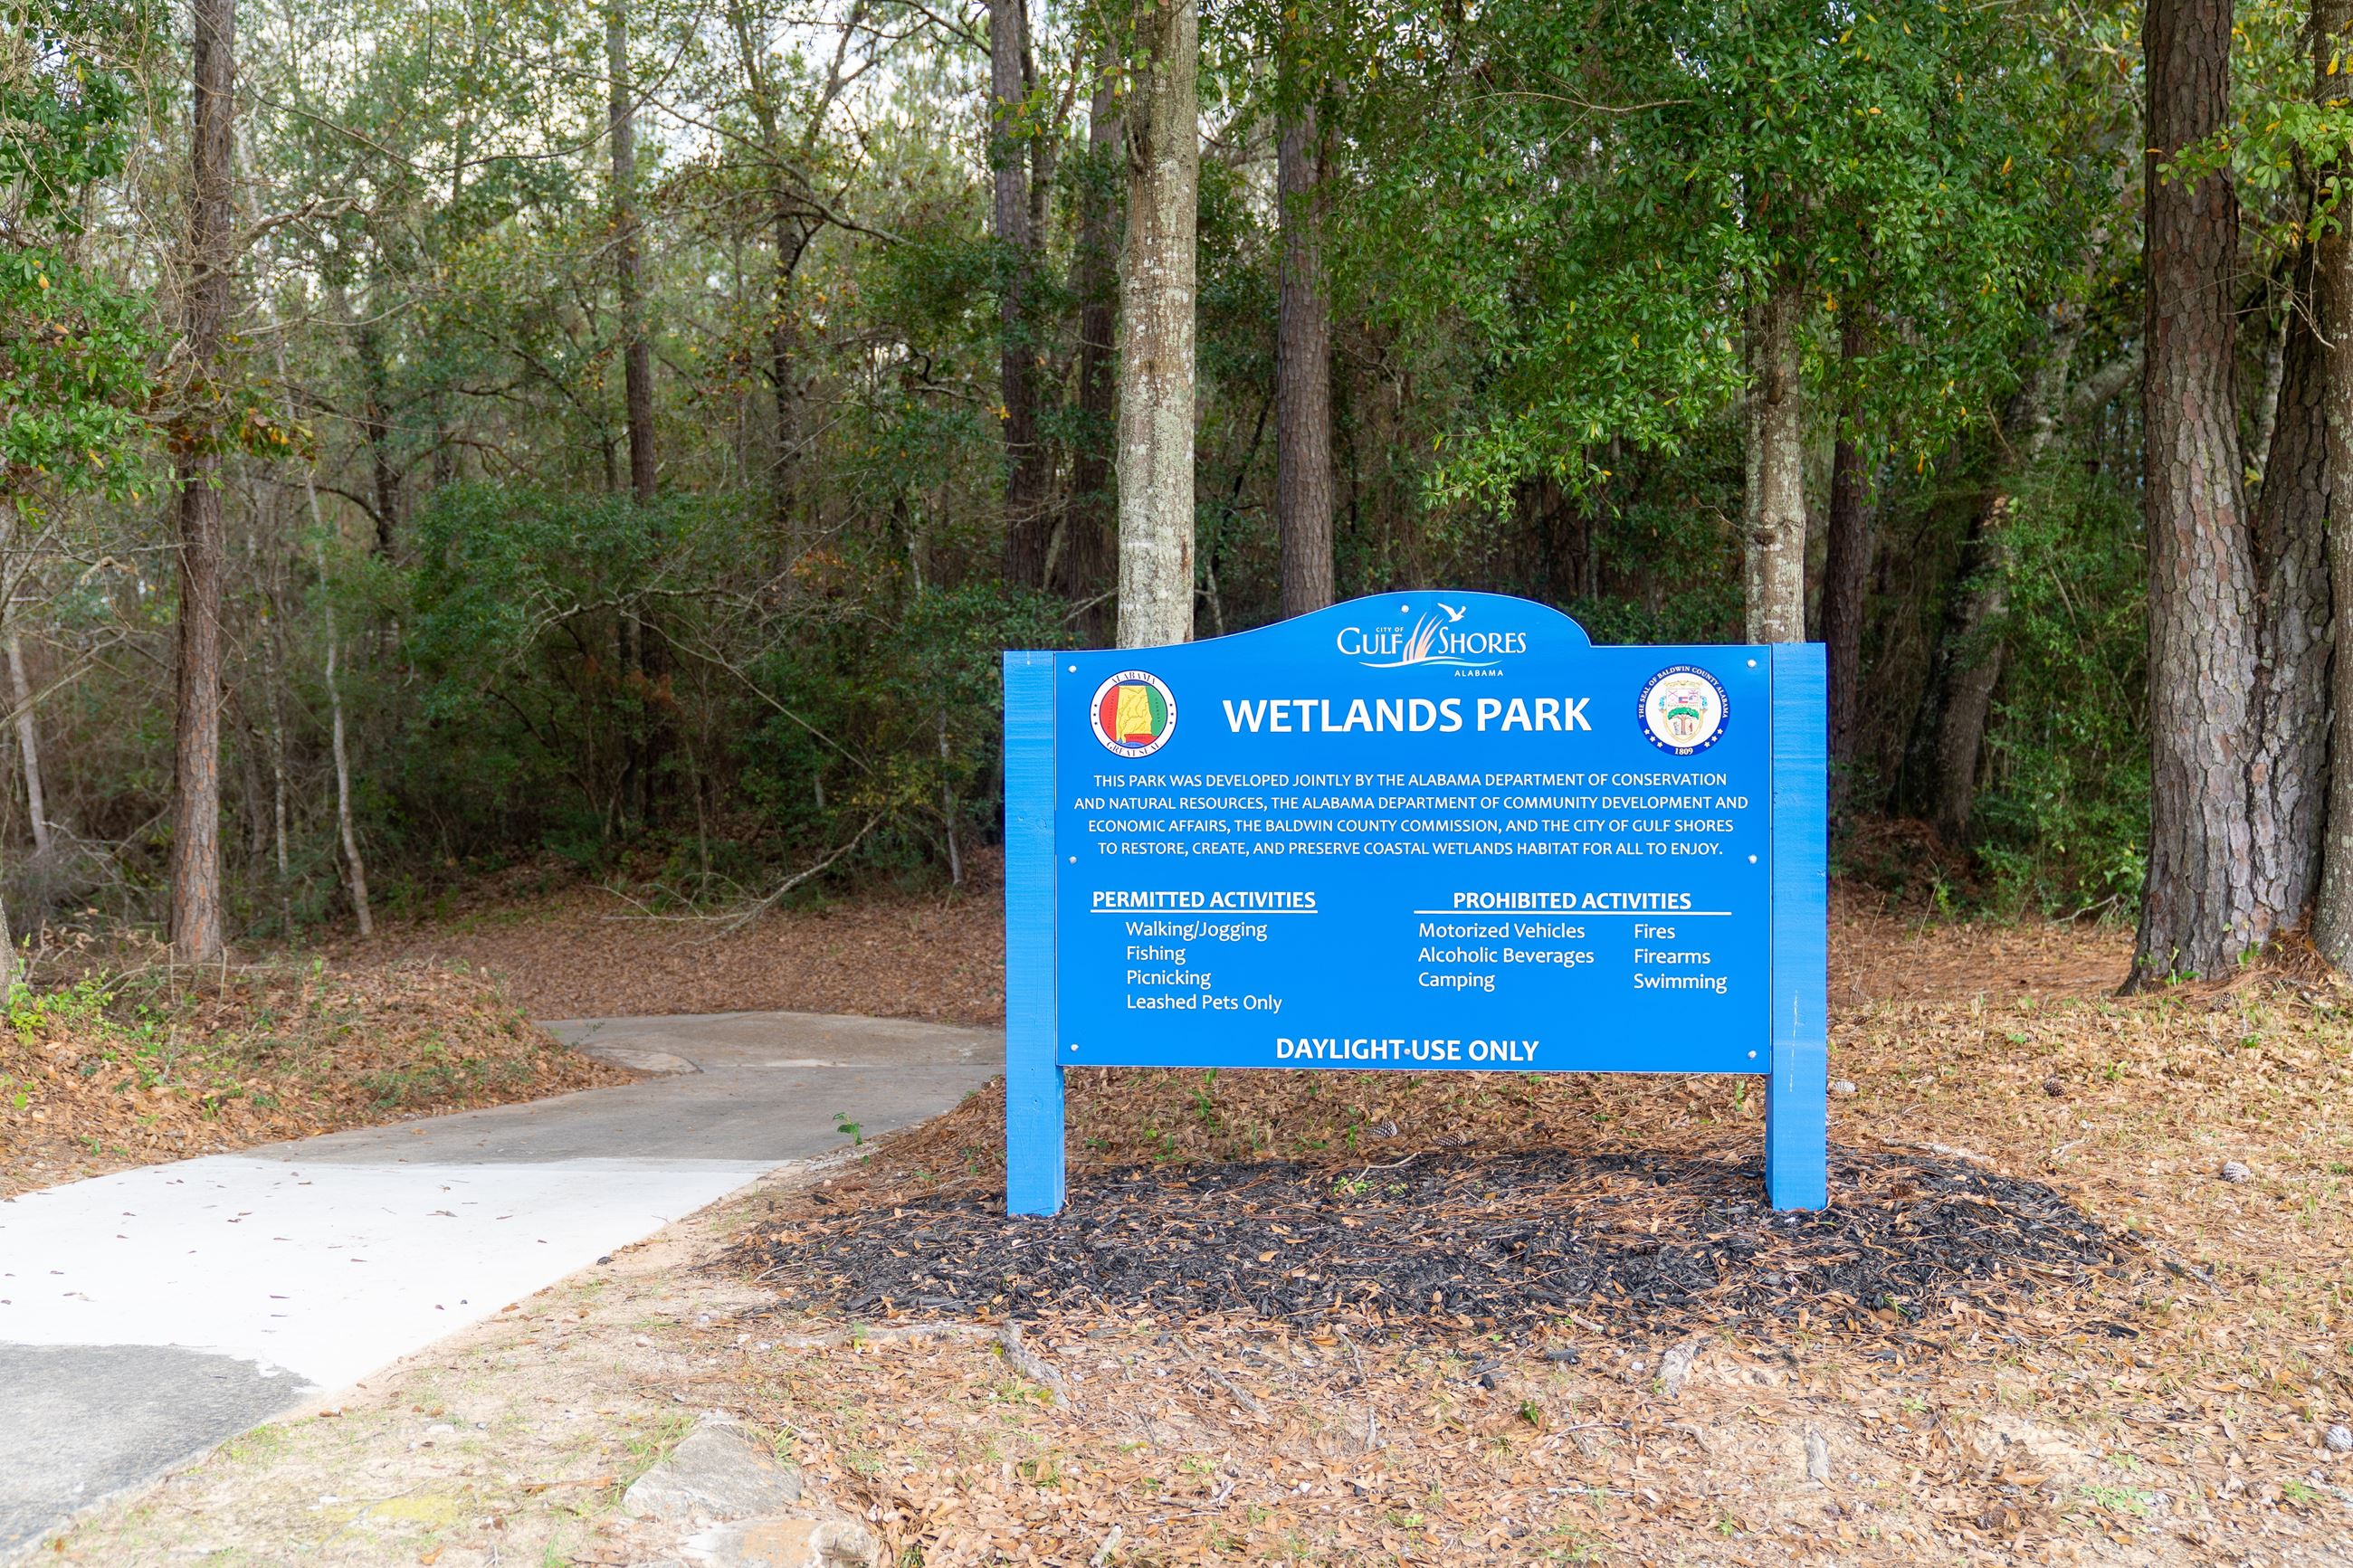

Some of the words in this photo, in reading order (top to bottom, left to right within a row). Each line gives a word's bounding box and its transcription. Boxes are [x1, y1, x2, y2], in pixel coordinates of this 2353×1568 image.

[1336, 627, 1404, 655] GULF
[1437, 626, 1527, 654] SHORES
[1111, 671, 1156, 685] ALABAMA
[1641, 687, 1651, 703] SEAL
[1650, 678, 1658, 687] OF
[1657, 665, 1691, 679] BALDWIN
[1691, 667, 1719, 685] COUNTY
[1716, 686, 1729, 718] ALABAMA
[1223, 698, 1462, 732] WETLANDS
[1478, 698, 1592, 731] PARK
[1106, 741, 1136, 756] GREAT
[1138, 742, 1163, 754] SEAL
[1674, 747, 1693, 755] 1809
[1094, 775, 1125, 787] THIS
[1129, 775, 1166, 786] PARK
[1170, 774, 1202, 786] WAS
[1206, 774, 1289, 786] DEVELOPED
[1293, 774, 1351, 786] JOINTLY
[1356, 774, 1374, 786] BY
[1377, 774, 1405, 785] THE
[1408, 774, 1481, 785] ALABAMA
[1486, 774, 1585, 785] DEPARTMENT
[1588, 774, 1608, 785] OF
[1612, 774, 1726, 785] CONSERVATION
[1074, 798, 1105, 809] AND
[1110, 798, 1176, 809] NATURAL
[1180, 797, 1267, 811] RESOURCES,
[1272, 797, 1299, 809] THE
[1302, 797, 1375, 809] ALABAMA
[1379, 797, 1477, 809] DEPARTMENT
[1481, 797, 1500, 809] OF
[1504, 797, 1597, 809] COMMUNITY
[1603, 796, 1711, 809] DEVELOPMENT
[1716, 797, 1748, 808] AND
[1089, 820, 1165, 832] ECONOMIC
[1168, 820, 1230, 833] AFFAIRS,
[1234, 820, 1262, 832] THE
[1266, 820, 1332, 832] BALDWIN
[1338, 820, 1396, 832] COUNTY
[1401, 820, 1501, 834] COMMISSION,
[1506, 820, 1538, 832] AND
[1542, 820, 1569, 832] THE
[1574, 820, 1605, 832] CITY
[1609, 820, 1628, 832] OF
[1633, 820, 1671, 832] GULF
[1675, 820, 1733, 832] SHORES
[1098, 842, 1117, 854] TO
[1122, 842, 1188, 857] RESTORE,
[1193, 842, 1249, 857] CREATE,
[1253, 843, 1284, 854] AND
[1290, 842, 1360, 854] PRESERVE
[1364, 842, 1429, 854] COASTAL
[1433, 842, 1512, 854] WETLANDS
[1518, 842, 1579, 854] HABITAT
[1584, 843, 1612, 854] FOR
[1616, 843, 1643, 854] ALL
[1646, 843, 1666, 854] TO
[1672, 843, 1722, 854] ENJOY.
[1093, 891, 1205, 908] PERMITTED
[1210, 892, 1315, 908] ACTIVITIES
[1454, 892, 1577, 908] PROHIBITED
[1582, 893, 1691, 909] ACTIVITIES
[1126, 921, 1267, 941] Walking/Jogging
[1419, 923, 1509, 937] Motorized
[1514, 923, 1585, 938] Vehicles
[1635, 924, 1675, 938] Fires
[1128, 946, 1186, 965] Fishing
[1418, 946, 1497, 963] Alcoholic
[1504, 947, 1594, 966] Beverages
[1635, 949, 1710, 964] Firearms
[1128, 970, 1211, 990] Picnicking
[1419, 972, 1495, 992] Camping
[1634, 974, 1727, 993] Swimming
[1128, 994, 1196, 1009] Leashed
[1203, 995, 1238, 1010] Pets
[1243, 994, 1281, 1013] Only
[1276, 1038, 1405, 1060] DAYLIGHT
[1412, 1040, 1462, 1061] USE
[1468, 1041, 1539, 1061] ONLY
